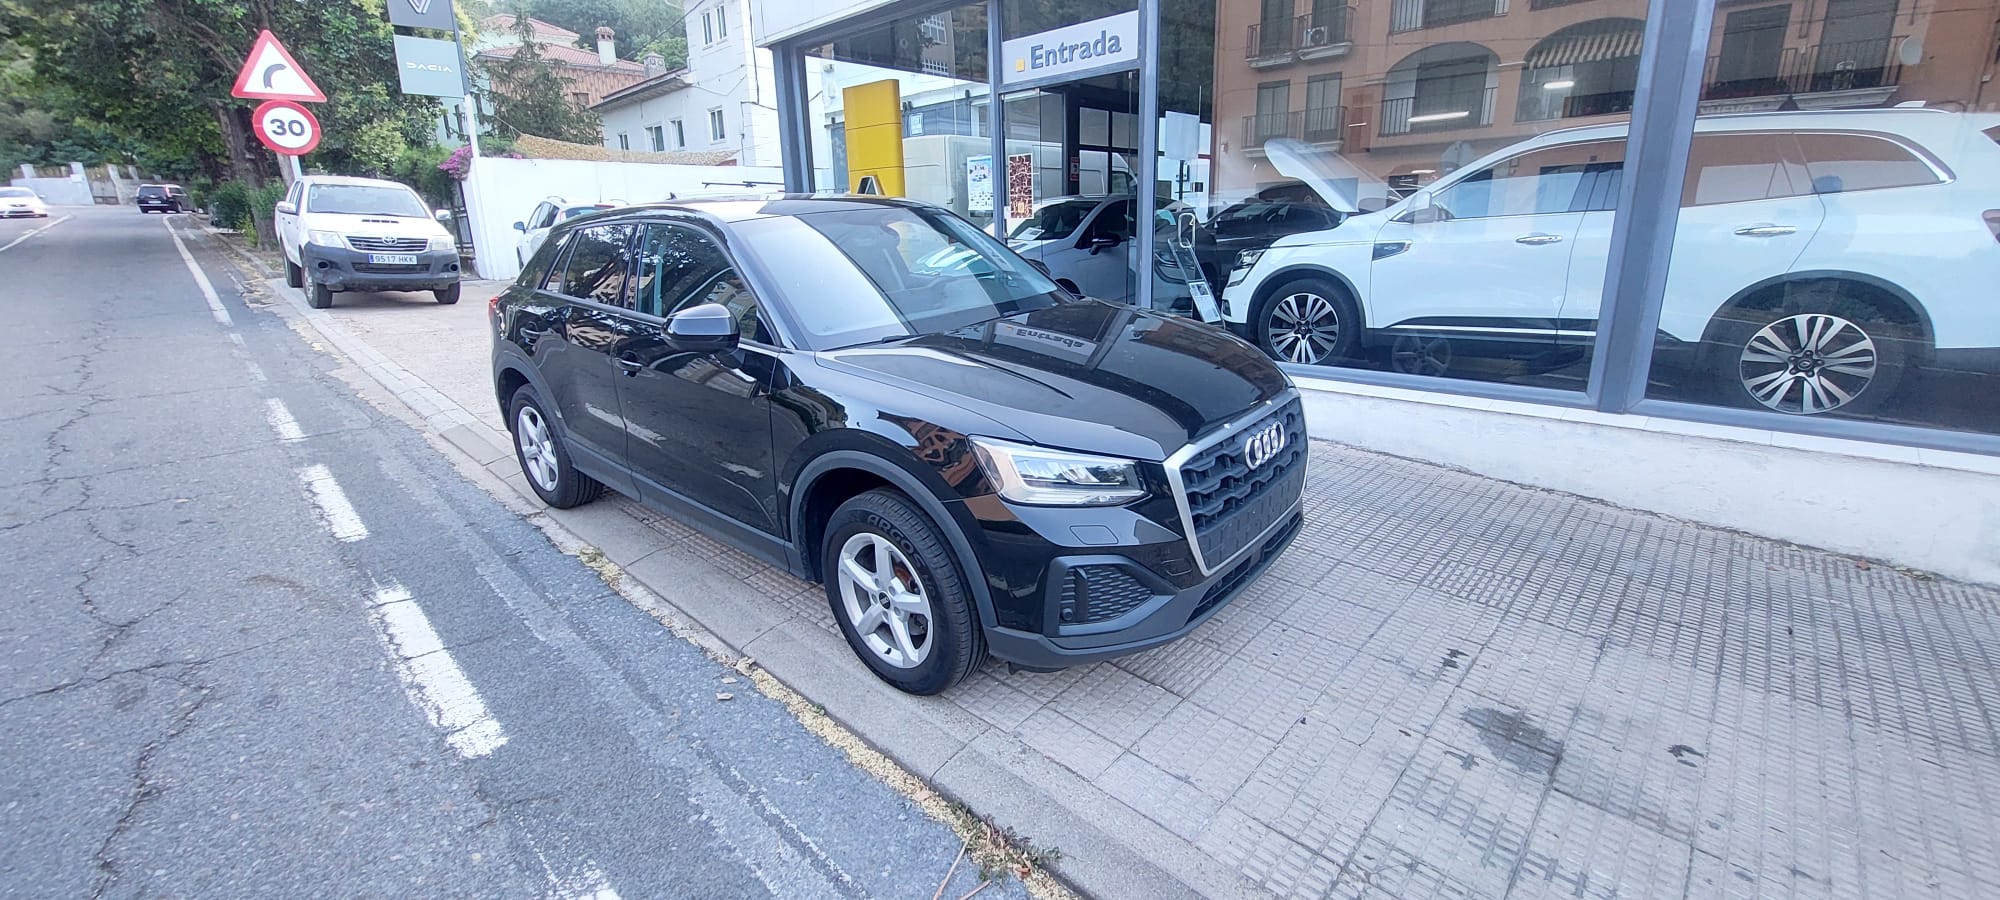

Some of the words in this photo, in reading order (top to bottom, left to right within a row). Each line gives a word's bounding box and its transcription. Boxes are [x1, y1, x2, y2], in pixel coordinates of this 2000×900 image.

[1030, 30, 1122, 69] Entrada
[405, 62, 453, 73] DACIA
[270, 118, 305, 137] 30
[374, 255, 396, 263] 9517
[867, 514, 926, 569] ARGOS
